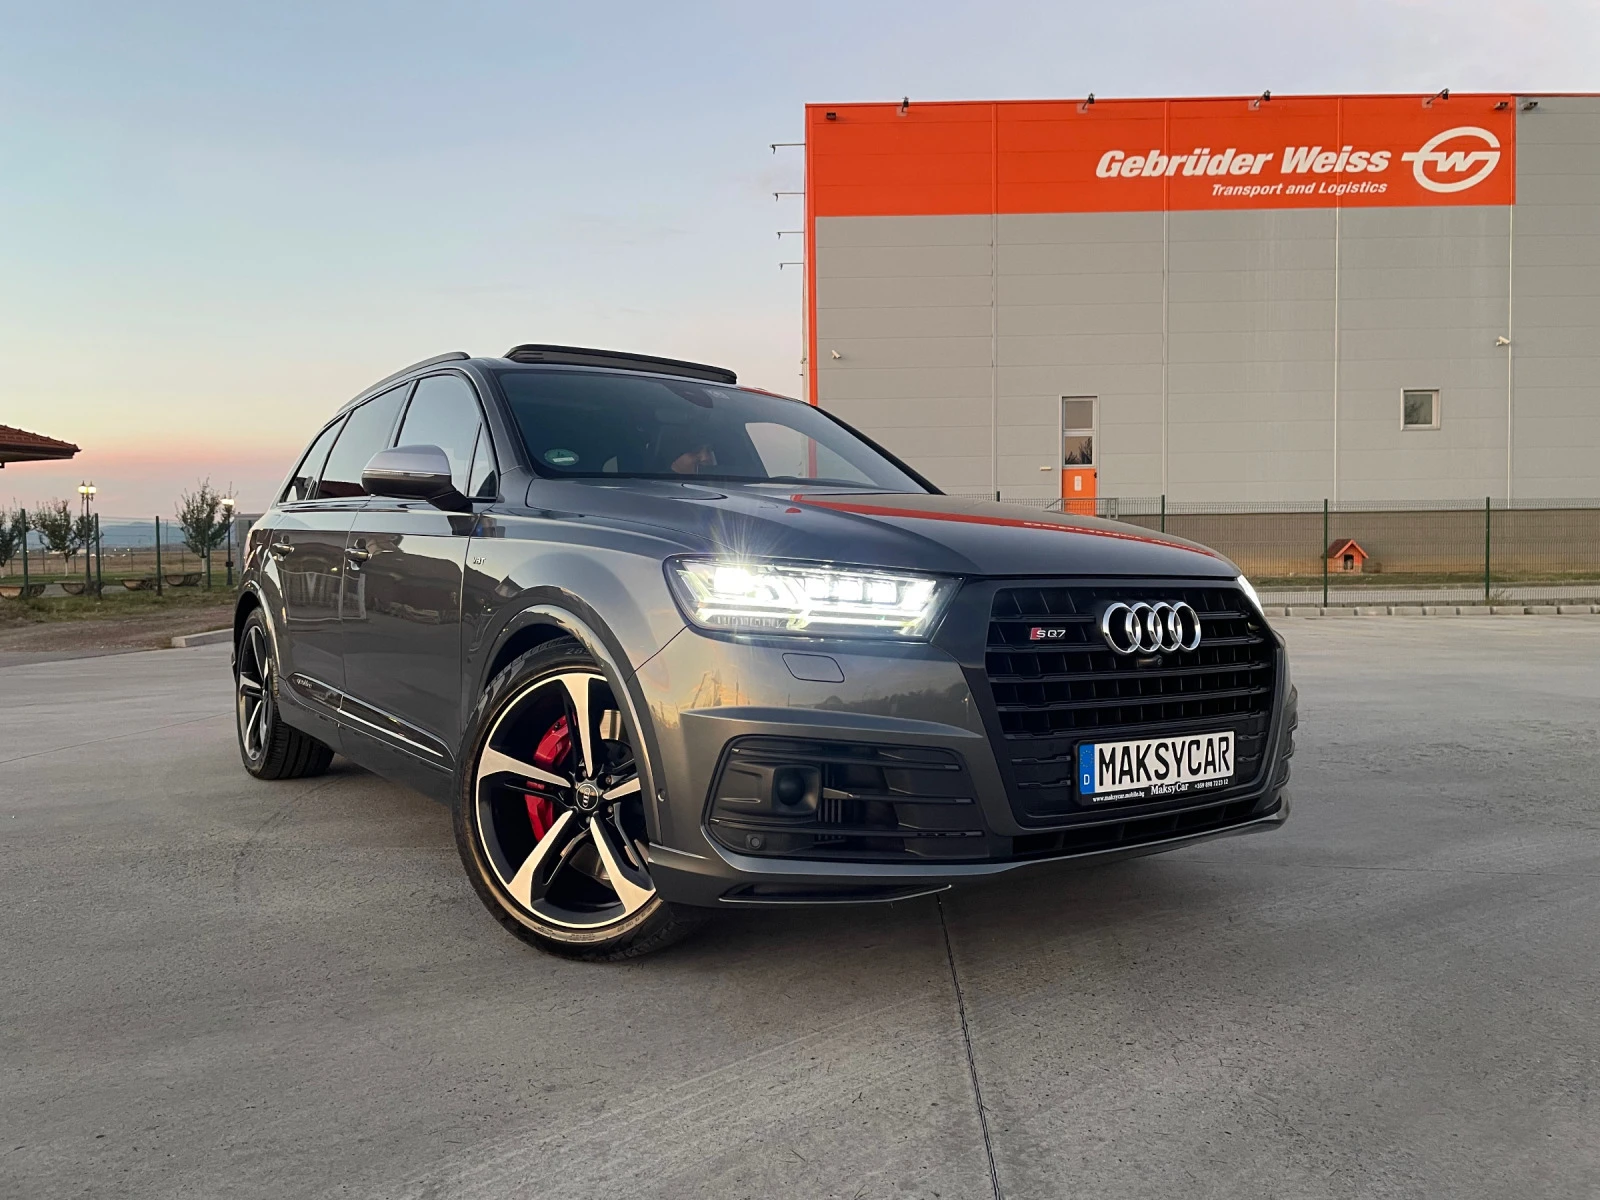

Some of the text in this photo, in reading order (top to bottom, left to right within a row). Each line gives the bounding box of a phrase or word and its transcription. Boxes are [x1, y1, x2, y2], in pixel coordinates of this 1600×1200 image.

[1096, 145, 1392, 179] Gebrüder Weiss
[1211, 180, 1388, 198] Transport and Logistics
[1098, 737, 1230, 786] MAKSYCAR
[1083, 774, 1090, 786] D
[1151, 782, 1189, 795] MaksyCar
